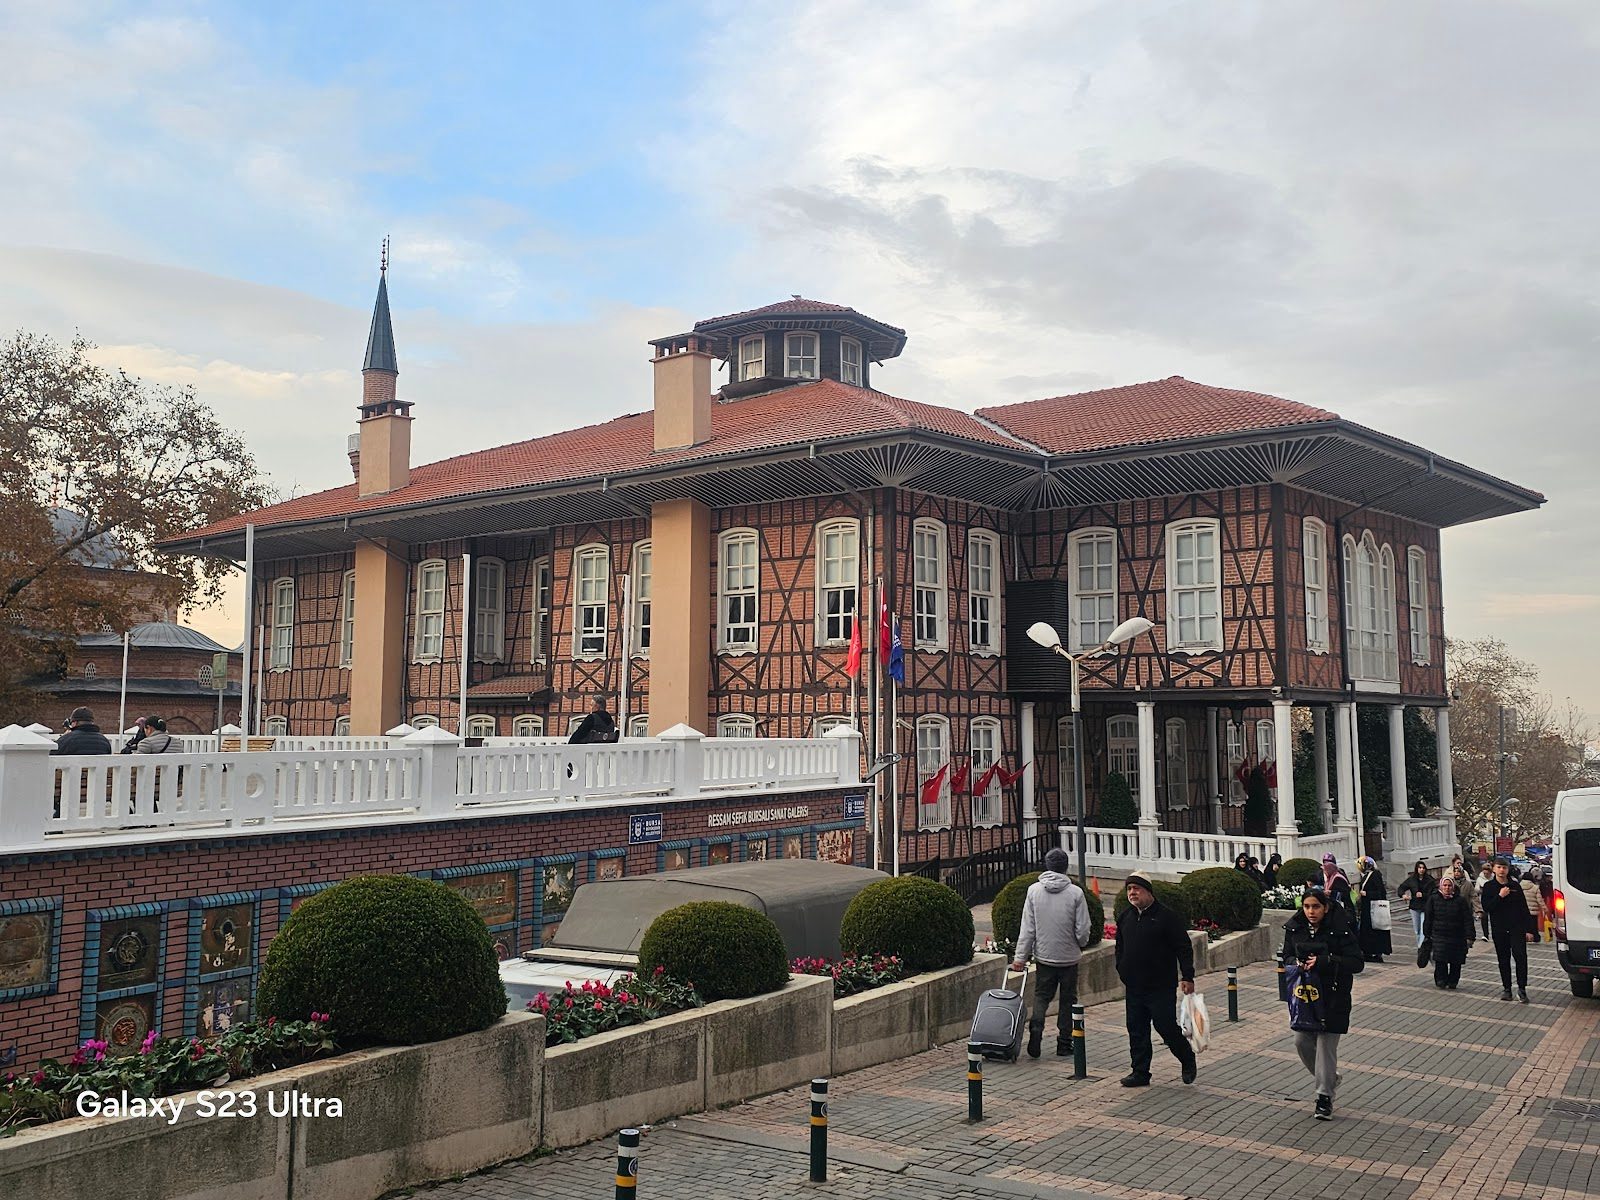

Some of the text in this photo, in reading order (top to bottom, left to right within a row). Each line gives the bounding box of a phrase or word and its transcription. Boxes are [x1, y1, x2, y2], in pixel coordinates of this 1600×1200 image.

[645, 819, 661, 827] BURSA
[708, 813, 732, 828] RESSAM
[732, 811, 748, 826] ŞEFİK
[748, 808, 771, 823] BURSALI
[771, 807, 788, 821] SANAT
